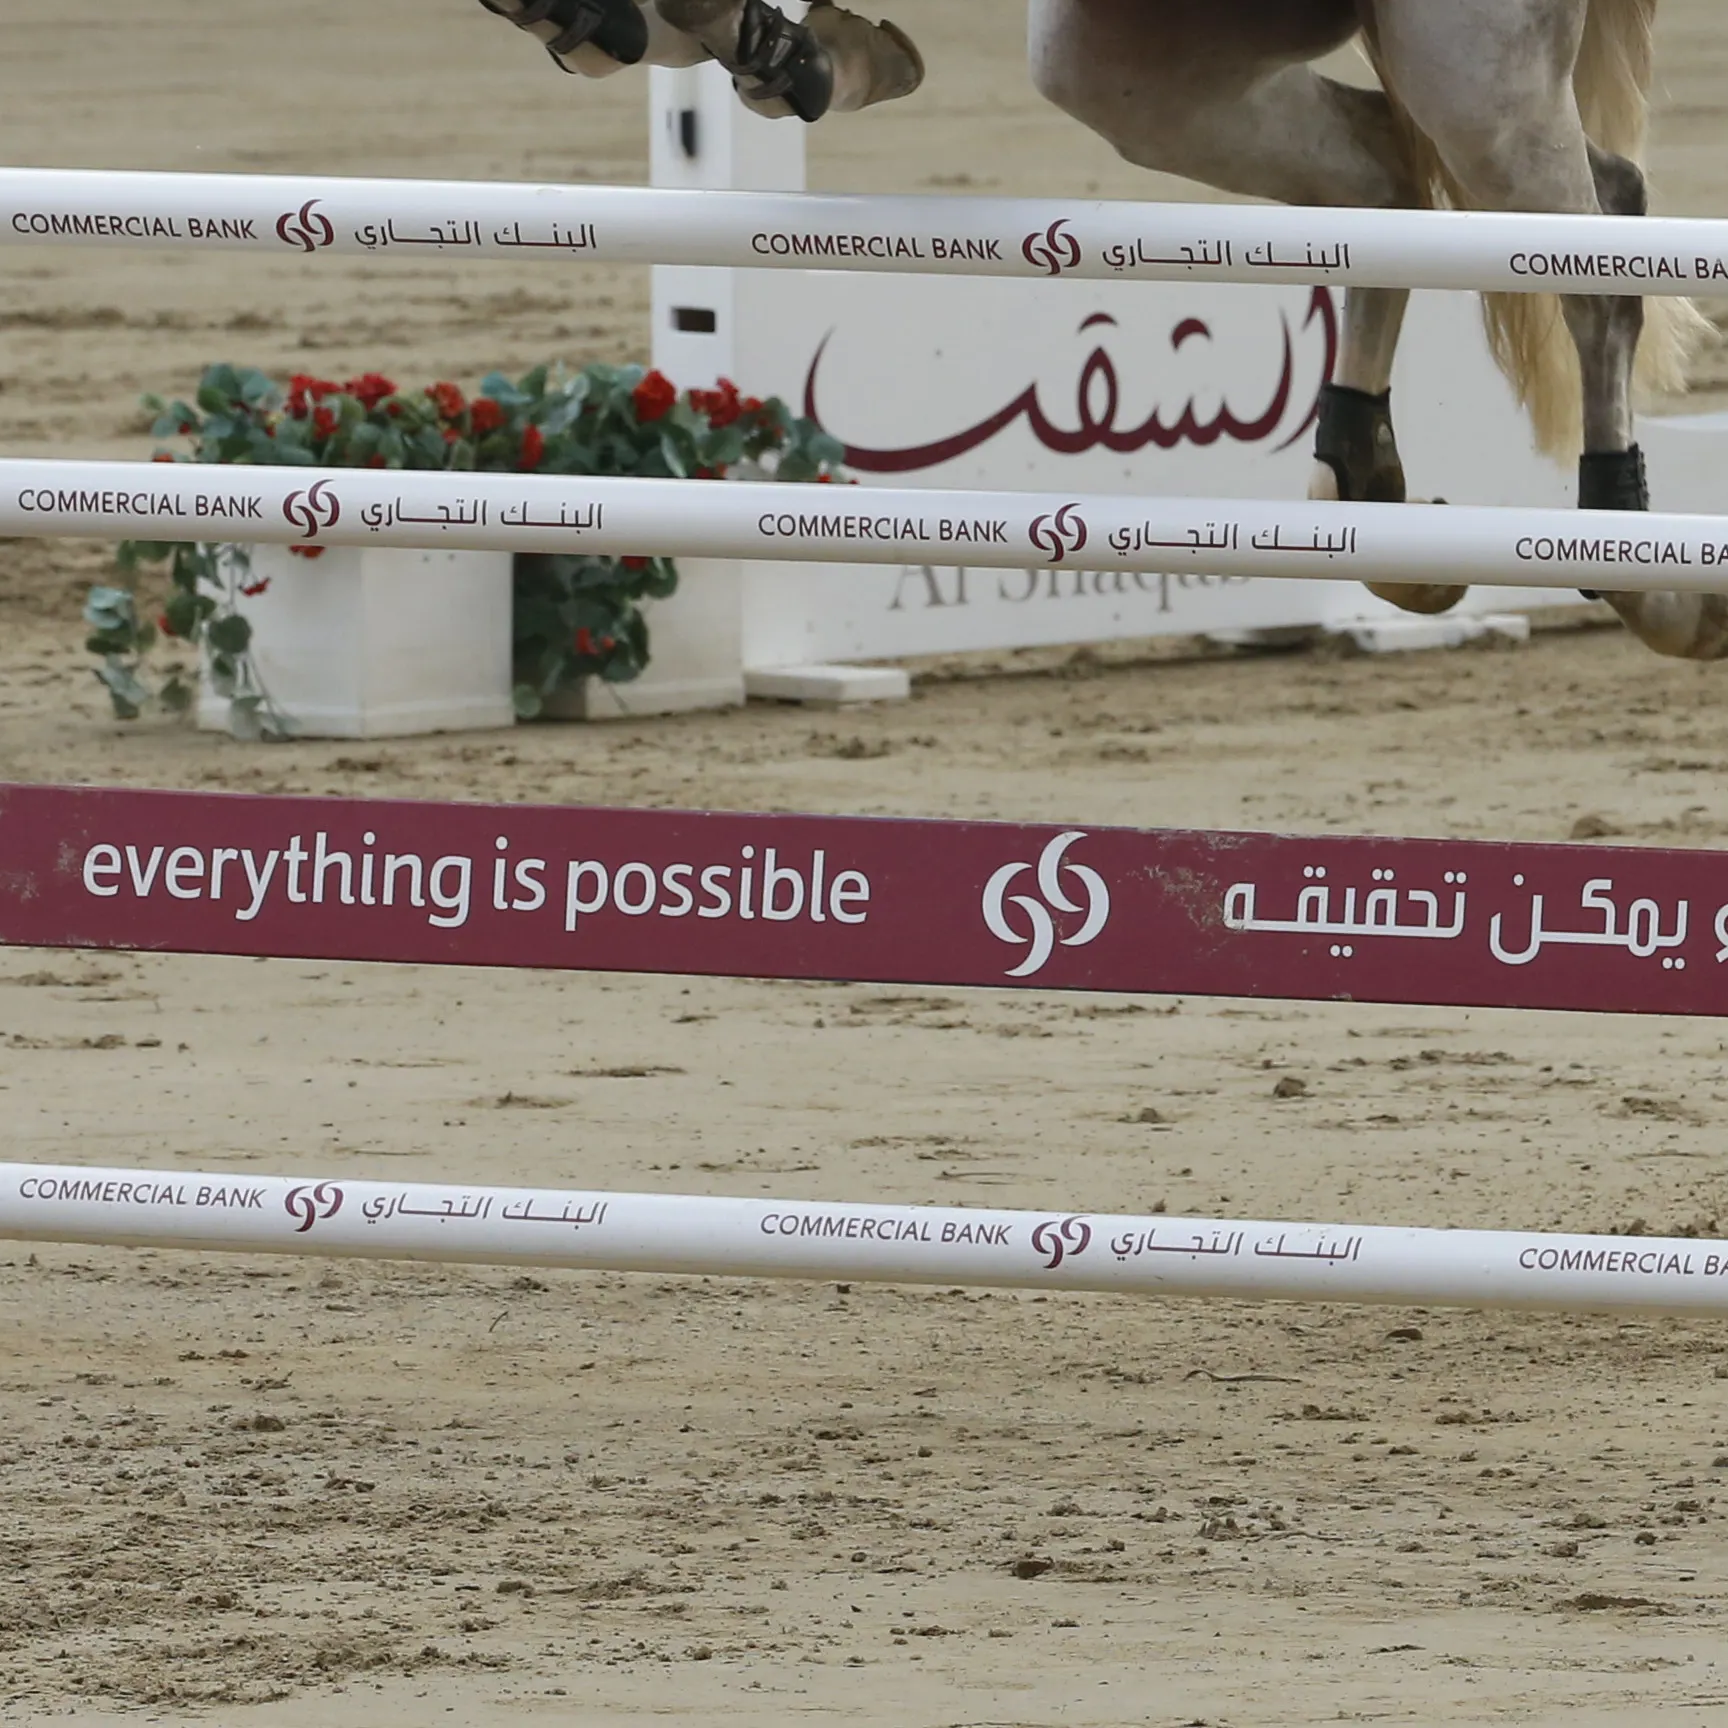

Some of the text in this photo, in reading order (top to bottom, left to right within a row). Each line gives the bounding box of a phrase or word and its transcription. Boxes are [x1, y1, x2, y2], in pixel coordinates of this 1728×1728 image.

[11, 212, 258, 240] COMMERCIAL BANK
[354, 218, 597, 253] البنك التجاري
[751, 232, 1003, 262] COMMERCIAL BANK
[1101, 238, 1351, 275] البنك التجاري
[1509, 252, 1687, 278] COMMERCIAL
[18, 488, 263, 519] COMMERCIAL BANK
[360, 496, 603, 535] البنك التجاري
[757, 513, 1009, 544] COMMERCIAL BANK
[1107, 520, 1357, 560] البنك التجاري
[1515, 536, 1693, 565] COMMERCIAL
[83, 831, 870, 932] everything is possible
[1223, 866, 1467, 957] تحقيقه
[1489, 874, 1688, 970] يمكن
[19, 1178, 267, 1209] COMMERCIAL BANK
[361, 1192, 609, 1231] البنك التجاري
[760, 1213, 1013, 1246] COMMERCIAL BANK
[1110, 1227, 1363, 1267] البنك التجاري
[1518, 1247, 1695, 1275] COMMERCIAL
